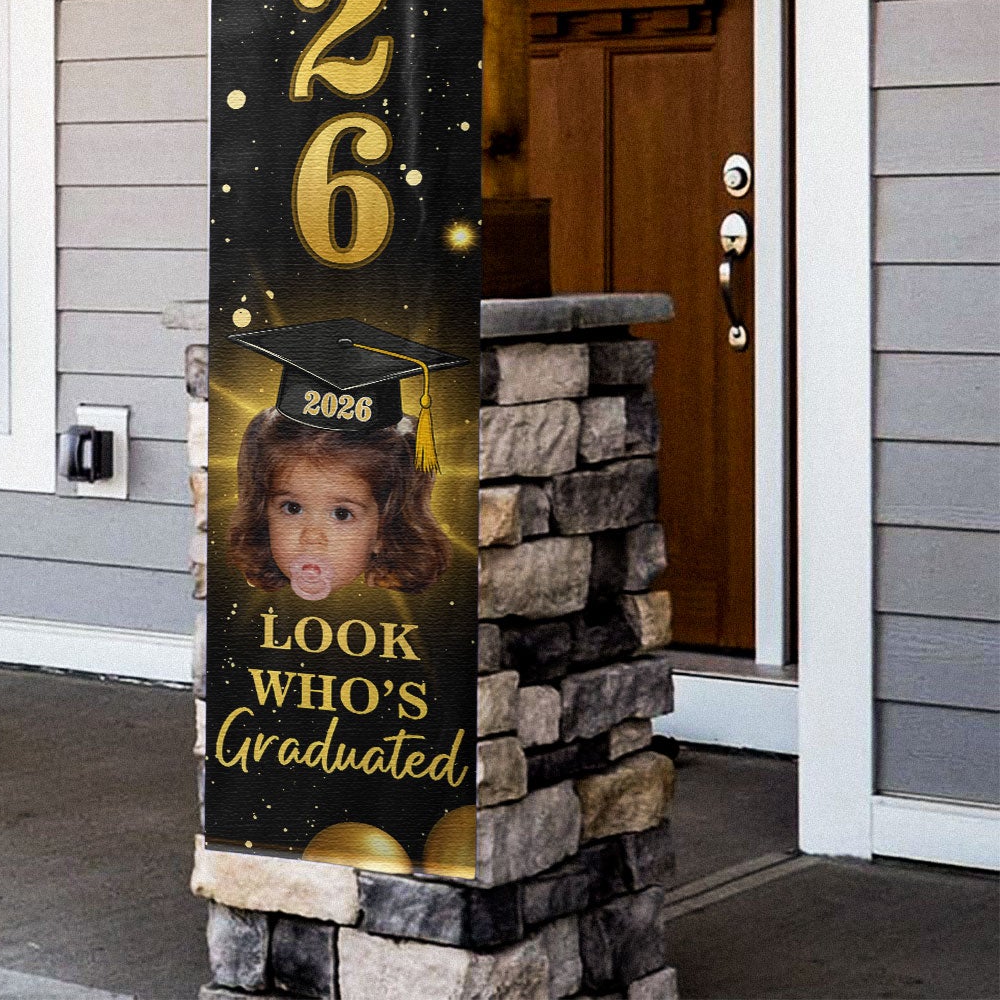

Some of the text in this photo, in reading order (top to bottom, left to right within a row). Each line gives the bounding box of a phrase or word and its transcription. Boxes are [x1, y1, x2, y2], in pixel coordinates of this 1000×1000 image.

[302, 390, 374, 422] 2026
[259, 612, 422, 662] LOOK
[247, 667, 429, 721] WHO'S
[215, 706, 469, 788] Graduated
